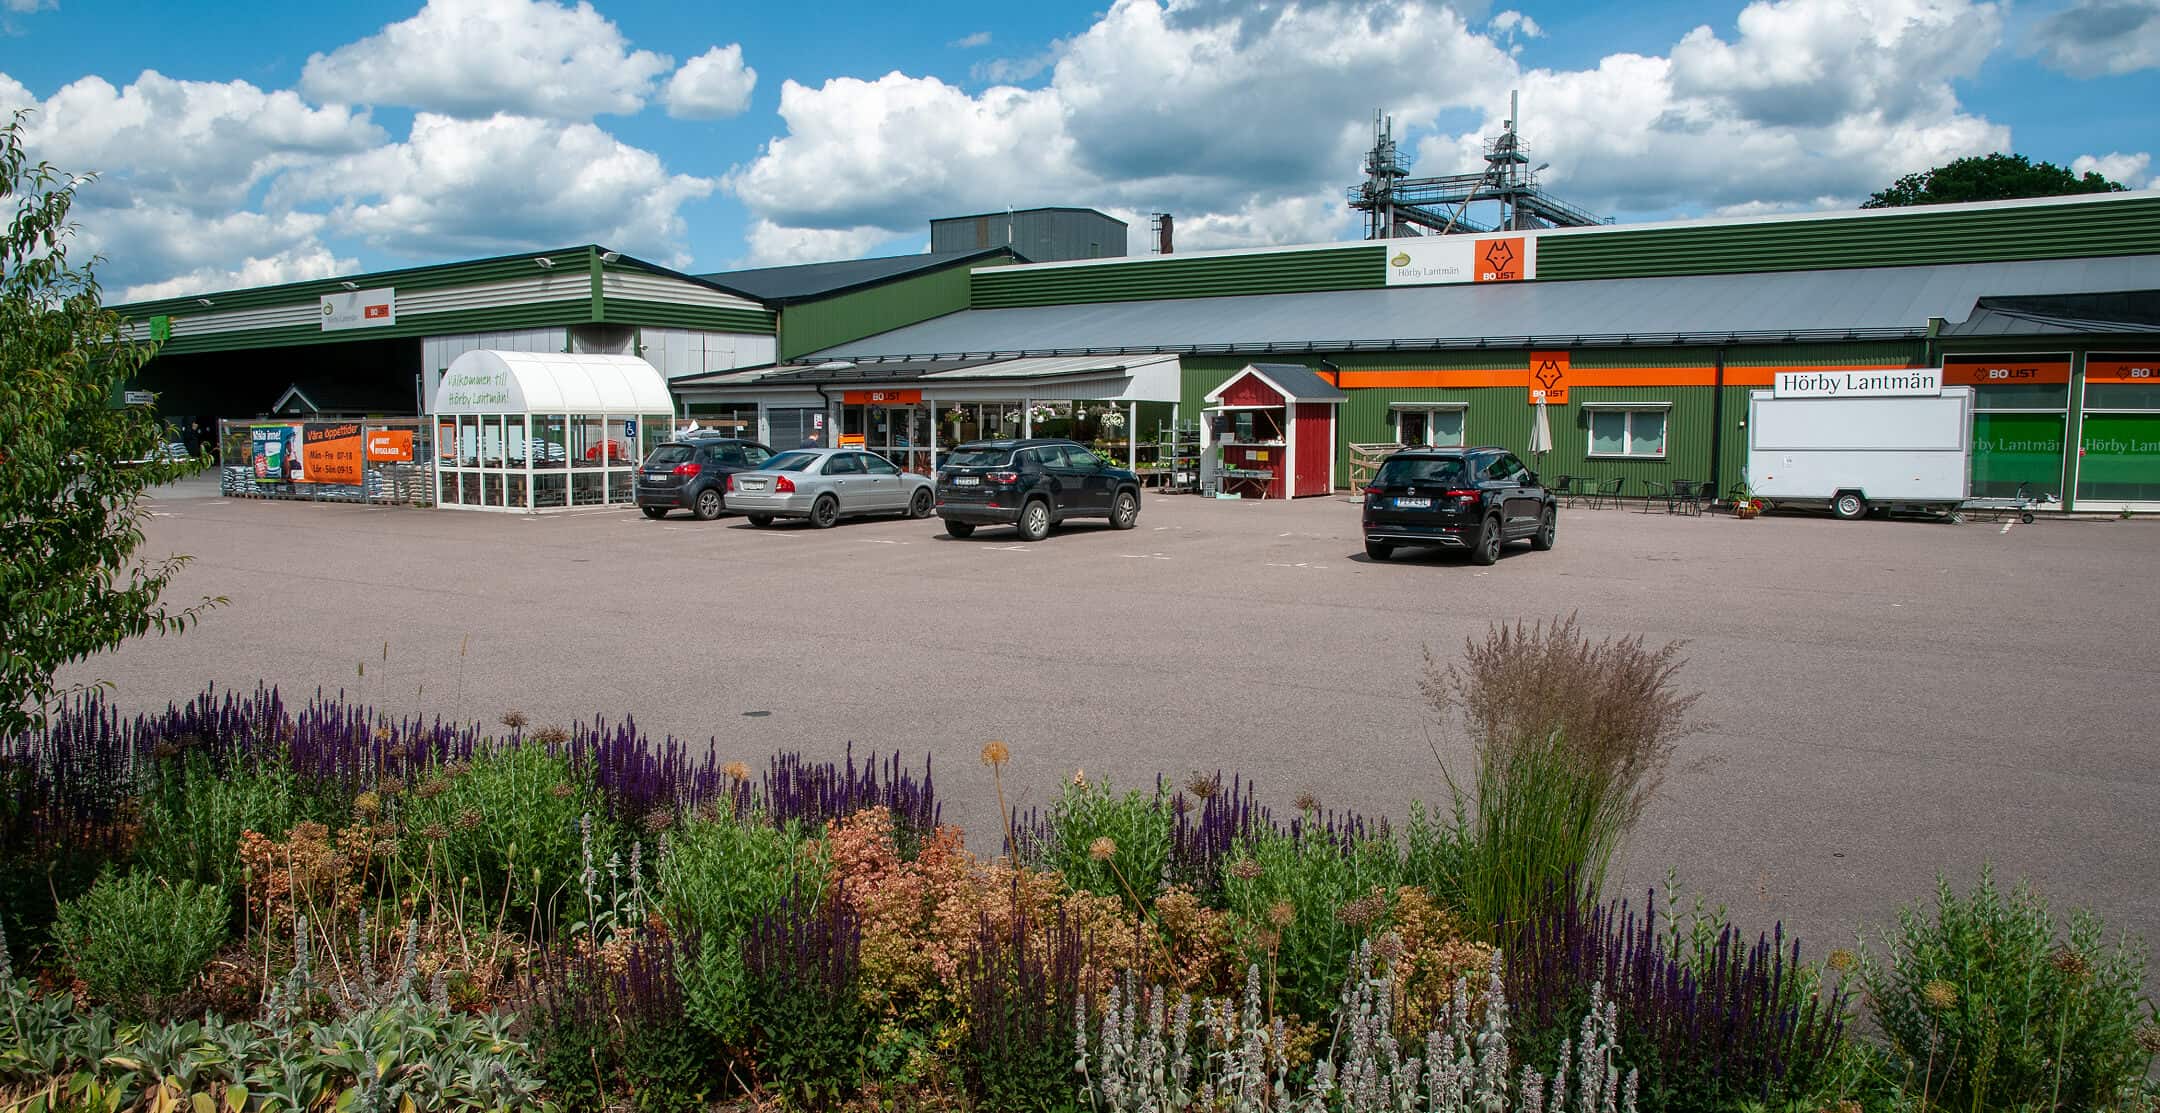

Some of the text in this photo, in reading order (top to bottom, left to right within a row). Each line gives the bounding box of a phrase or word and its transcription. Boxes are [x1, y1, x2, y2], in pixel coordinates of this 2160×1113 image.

[1398, 266, 1461, 278] Hörby Lantmän
[1482, 271, 1516, 281] BOLIST
[1988, 368, 2039, 379] BOLIST
[1783, 372, 1934, 395] Hörby Lantmän
[448, 391, 471, 407] Hörby
[872, 391, 900, 401] BOLIST
[307, 424, 359, 441] Våra öppettider
[2086, 439, 2128, 454] Hörby
